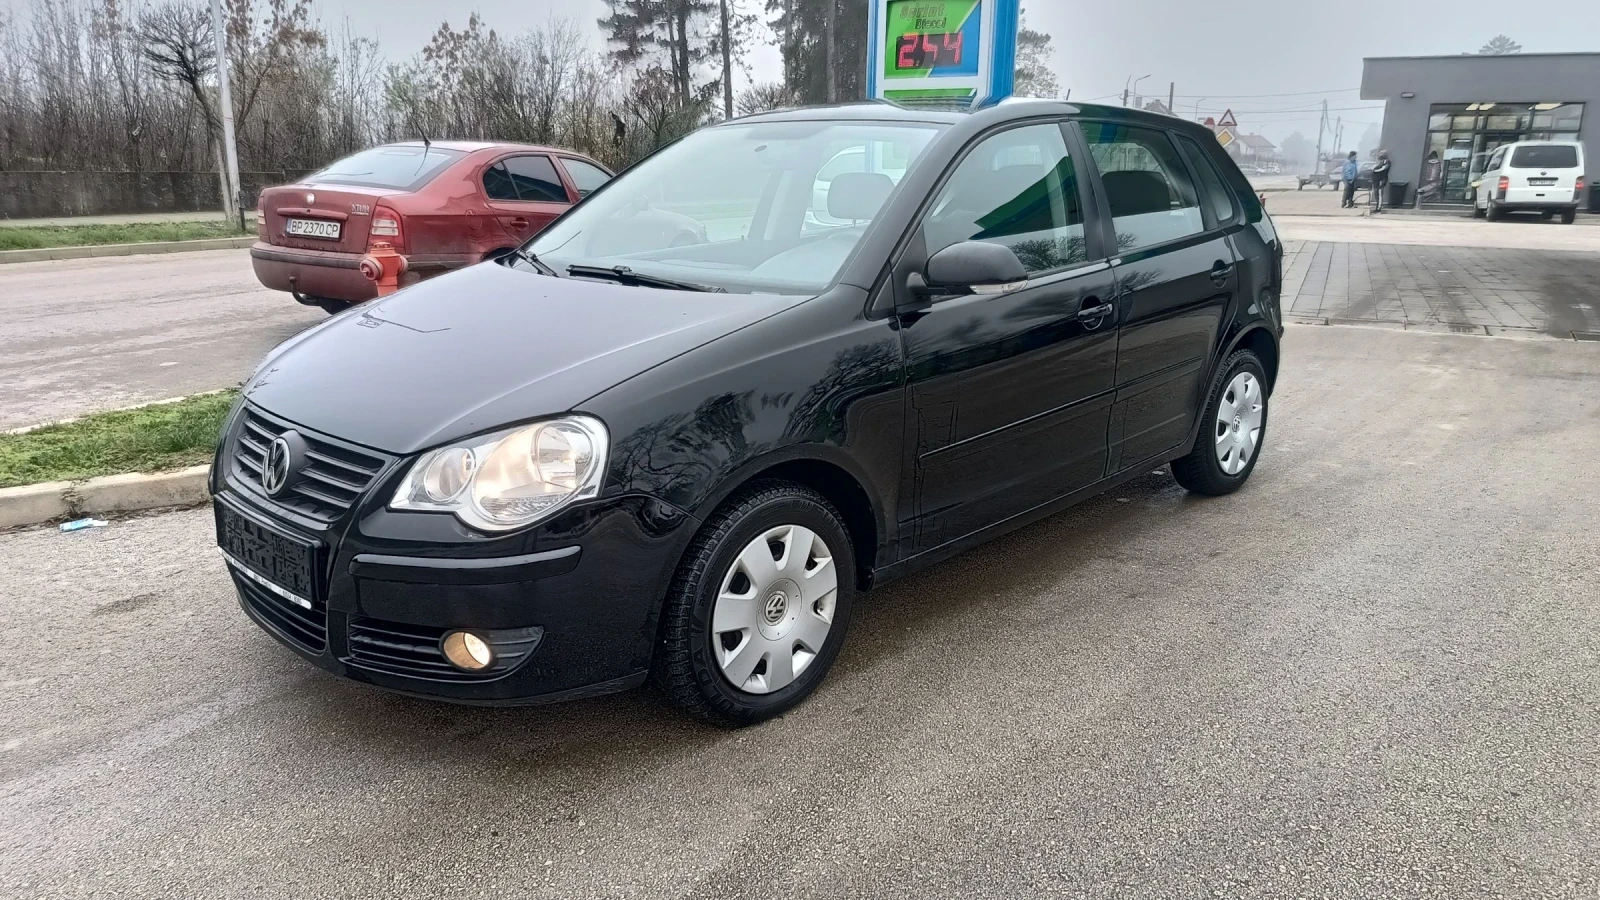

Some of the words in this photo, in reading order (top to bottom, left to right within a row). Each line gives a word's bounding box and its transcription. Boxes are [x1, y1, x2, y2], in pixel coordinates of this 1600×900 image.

[900, 3, 946, 20] Sprint
[914, 17, 947, 29] Diesel
[291, 220, 303, 233] BP
[303, 221, 325, 235] 2370
[326, 223, 339, 237] CP
